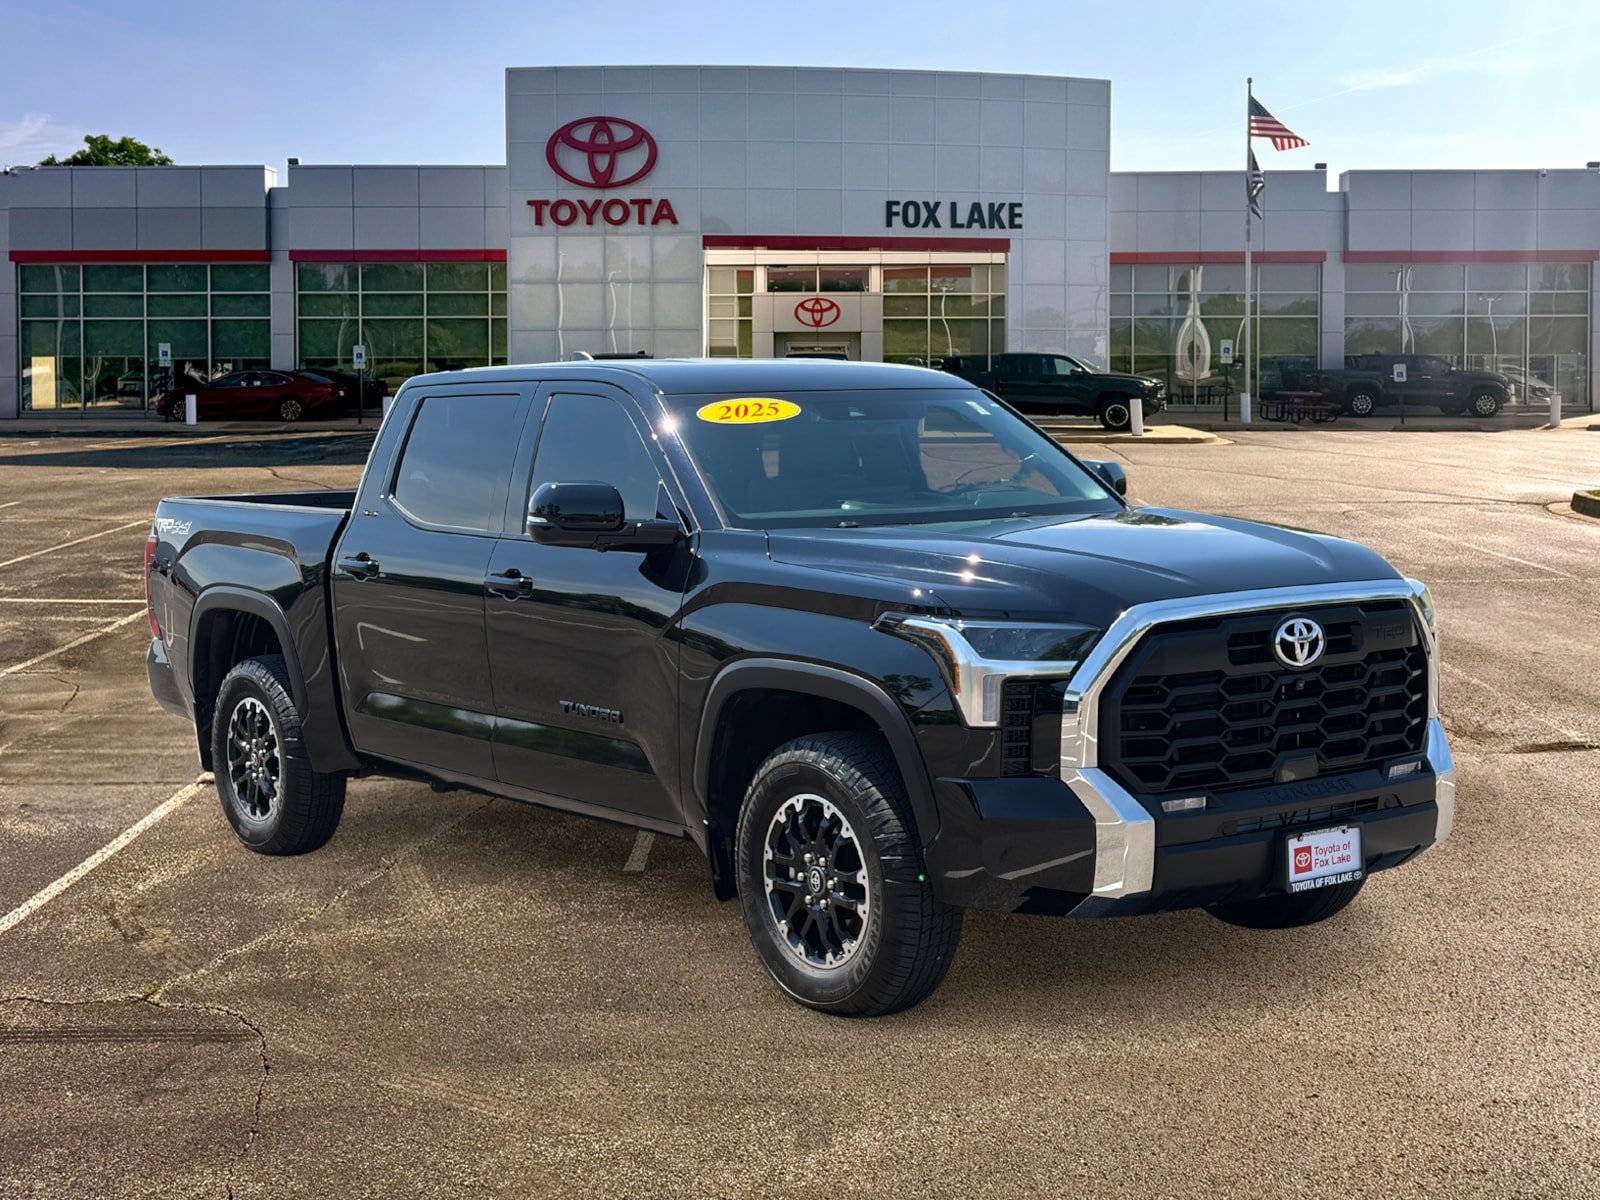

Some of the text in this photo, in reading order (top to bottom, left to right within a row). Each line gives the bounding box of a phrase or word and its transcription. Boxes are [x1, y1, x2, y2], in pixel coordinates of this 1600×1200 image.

[527, 199, 679, 226] TOYOTA
[885, 200, 1023, 229] FOX LAKE
[718, 402, 779, 420] 2025
[559, 700, 623, 725] TUNDRA
[1314, 840, 1351, 857] Toyota of
[1314, 853, 1351, 868] Fox Lake
[1291, 872, 1353, 892] TOYOTA OF FOX LAKE
